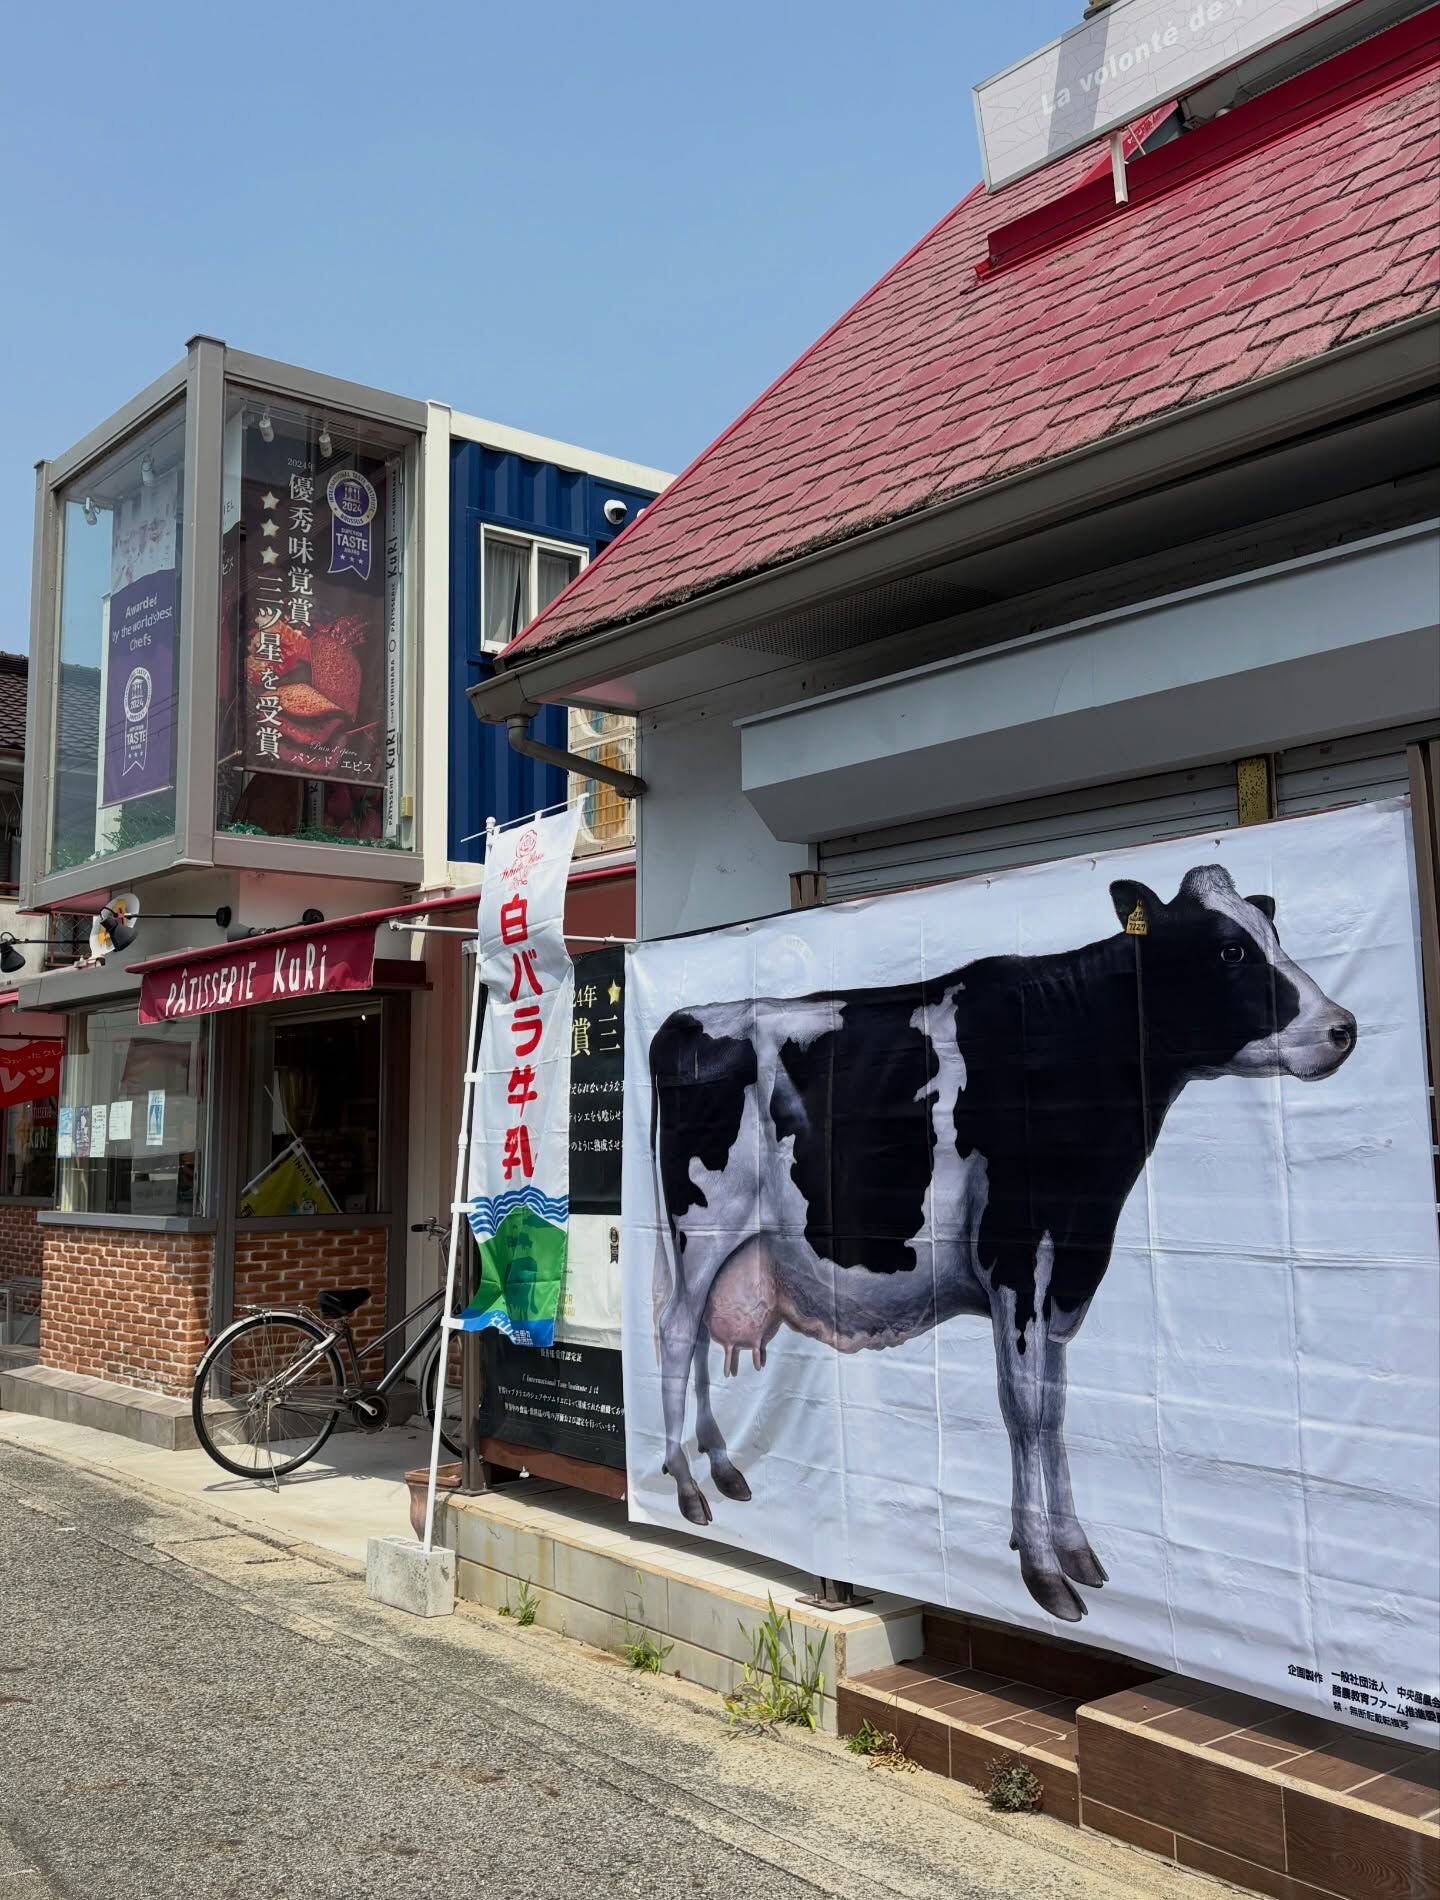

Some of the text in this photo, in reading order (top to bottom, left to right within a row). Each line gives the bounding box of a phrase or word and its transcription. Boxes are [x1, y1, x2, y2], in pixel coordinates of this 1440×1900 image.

[1041, 0, 1223, 116] La volonté de
[288, 472, 314, 627] 優秀味覚賞
[336, 533, 368, 551] TASTE
[342, 501, 362, 514] 2024
[256, 575, 284, 759] 三ツ星を受賞
[165, 943, 327, 1017] PÂTISSERIE KuRi
[500, 893, 543, 1180] 白バラ牛乳
[1331, 1670, 1388, 1695] 一般社団法人
